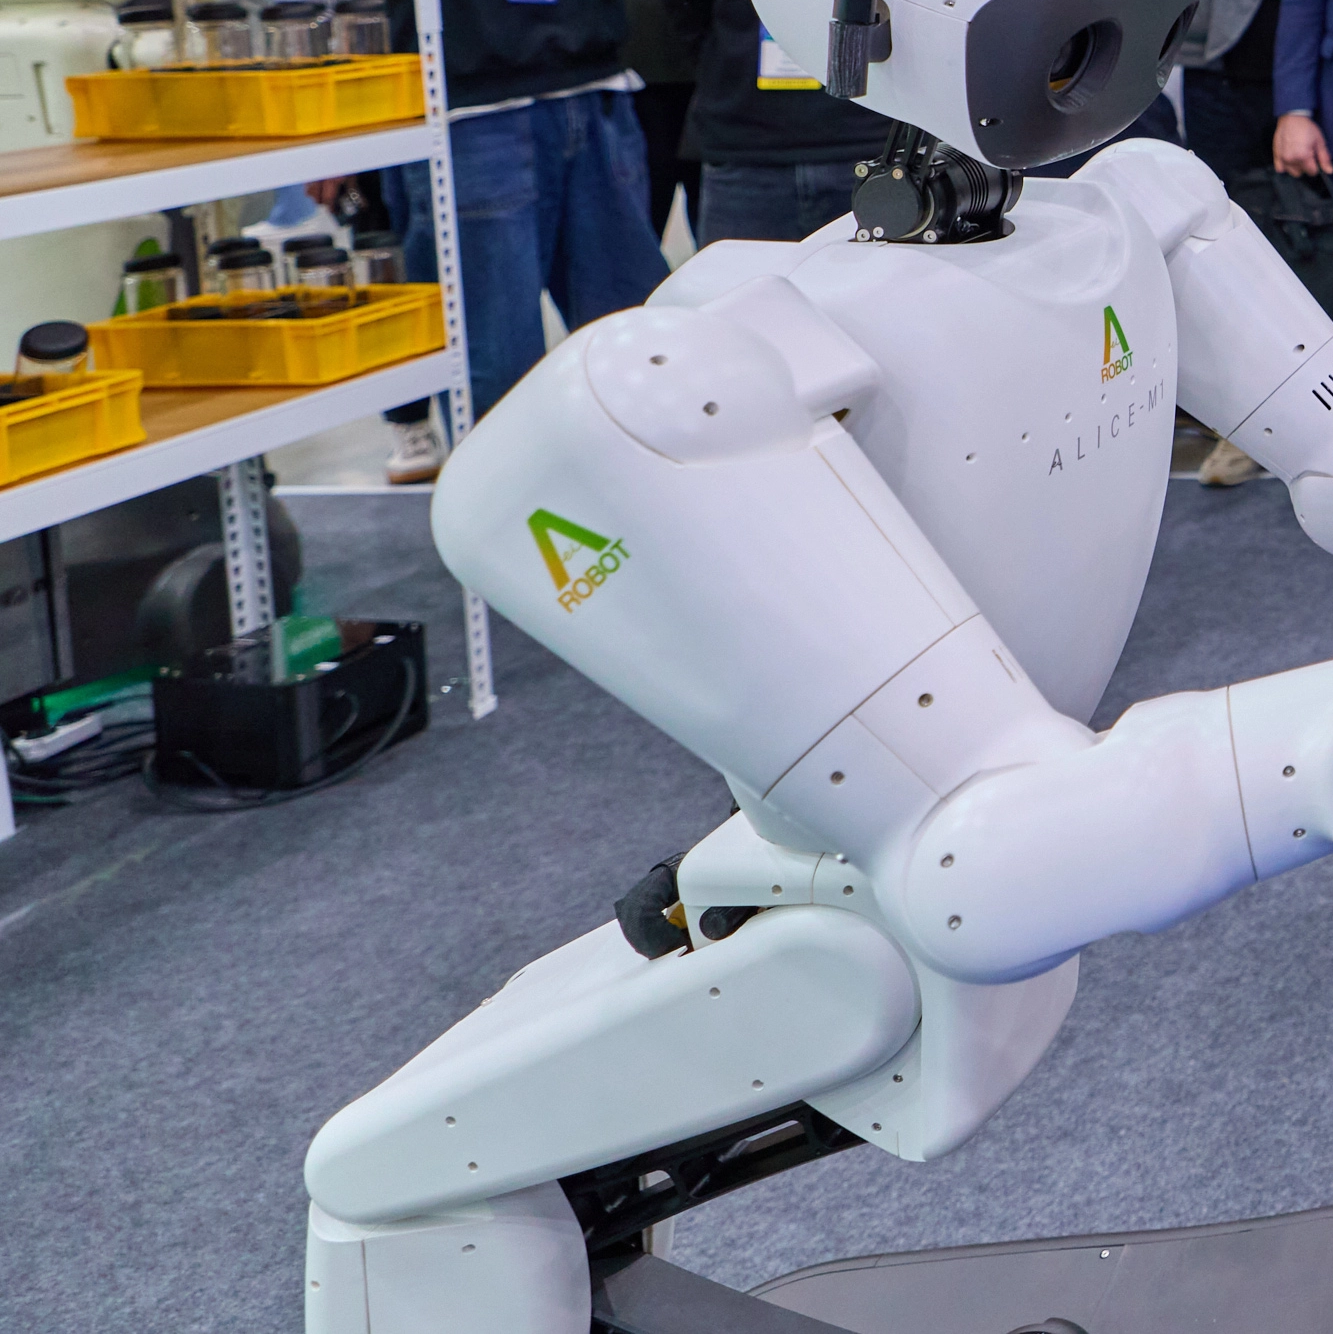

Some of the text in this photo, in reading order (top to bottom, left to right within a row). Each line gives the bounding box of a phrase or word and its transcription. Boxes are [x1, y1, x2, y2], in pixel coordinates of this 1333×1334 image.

[1101, 351, 1133, 385] ROBOT
[1048, 378, 1165, 477] ALICE-M1
[557, 538, 630, 614] ROBOT
